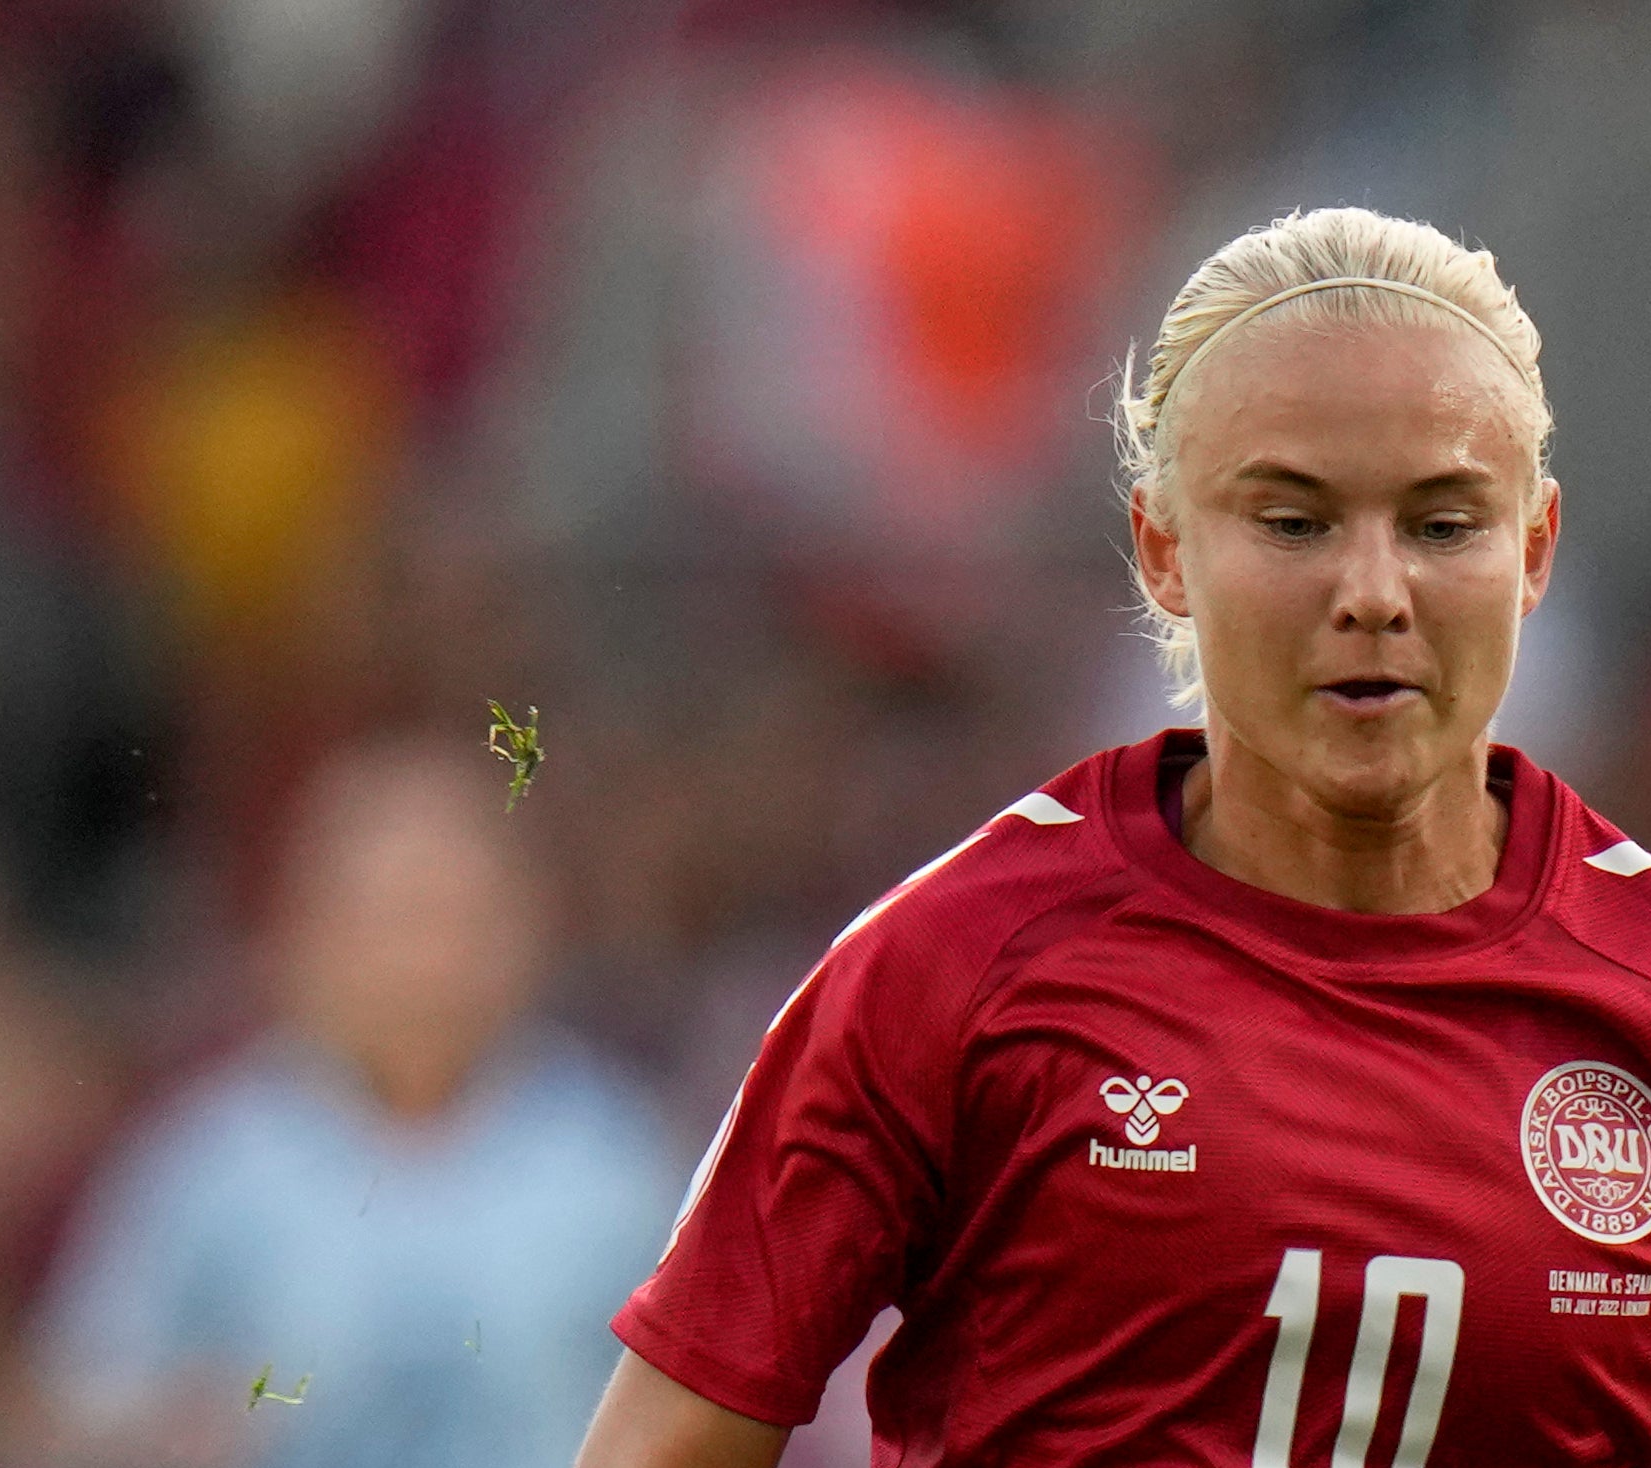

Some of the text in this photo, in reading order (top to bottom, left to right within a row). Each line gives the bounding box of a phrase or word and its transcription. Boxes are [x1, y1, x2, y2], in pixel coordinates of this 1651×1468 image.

[1089, 1138, 1197, 1172] hummel
[1529, 1110, 1573, 1212] DANSK
[1554, 1122, 1645, 1174] DBU
[1579, 1208, 1637, 1233] 1889
[1549, 1270, 1609, 1294] DENMARK
[1573, 1299, 1597, 1315] JULY
